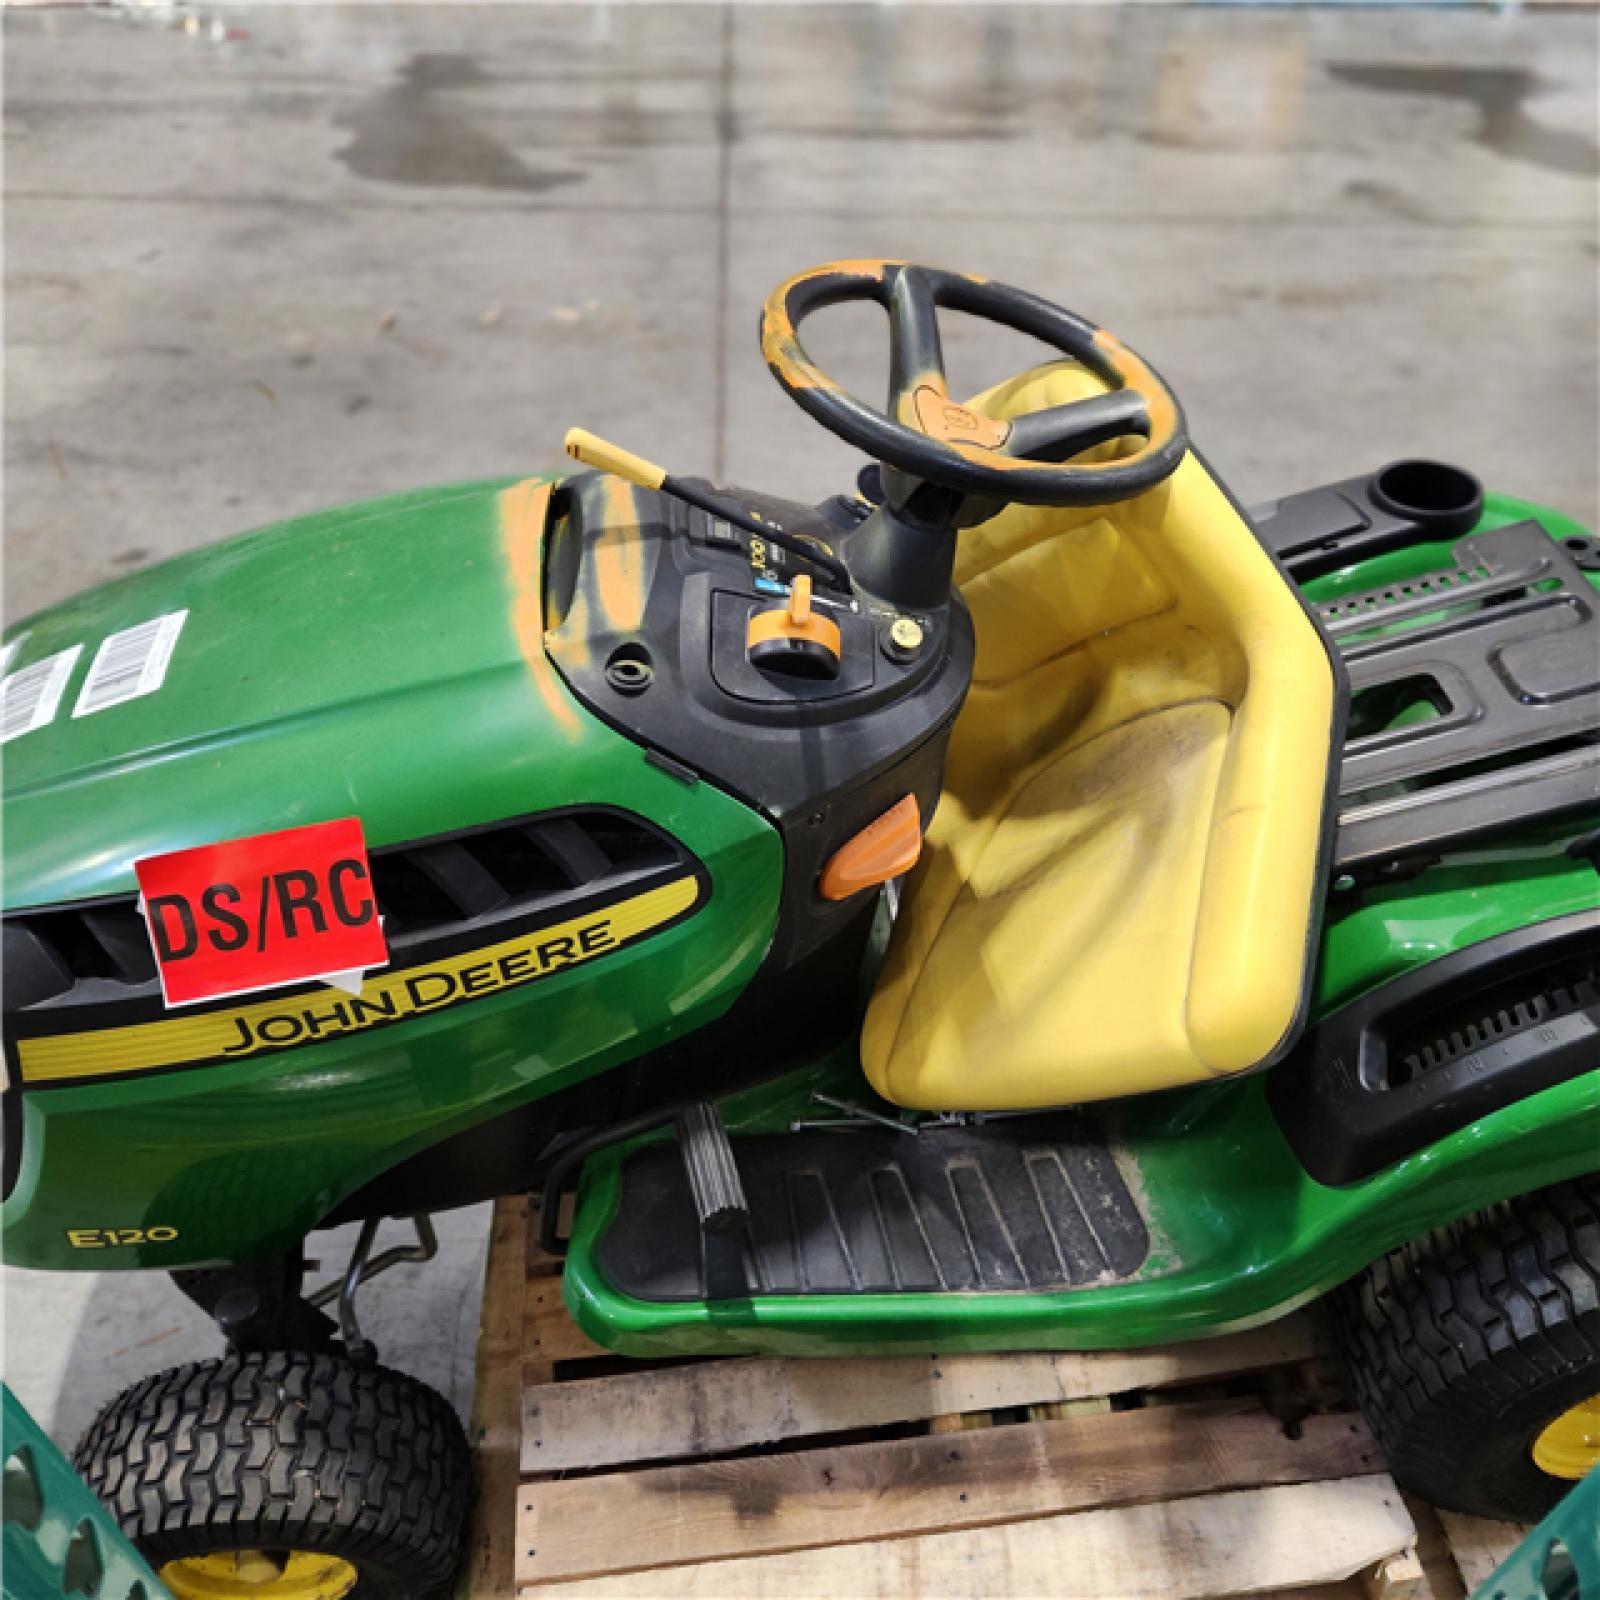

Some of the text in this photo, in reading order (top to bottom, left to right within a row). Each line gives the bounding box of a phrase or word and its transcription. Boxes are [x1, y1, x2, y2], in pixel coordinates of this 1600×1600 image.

[148, 859, 374, 963] DS/RC
[222, 919, 617, 1054] JOHN DEERE
[66, 1226, 178, 1249] E120
